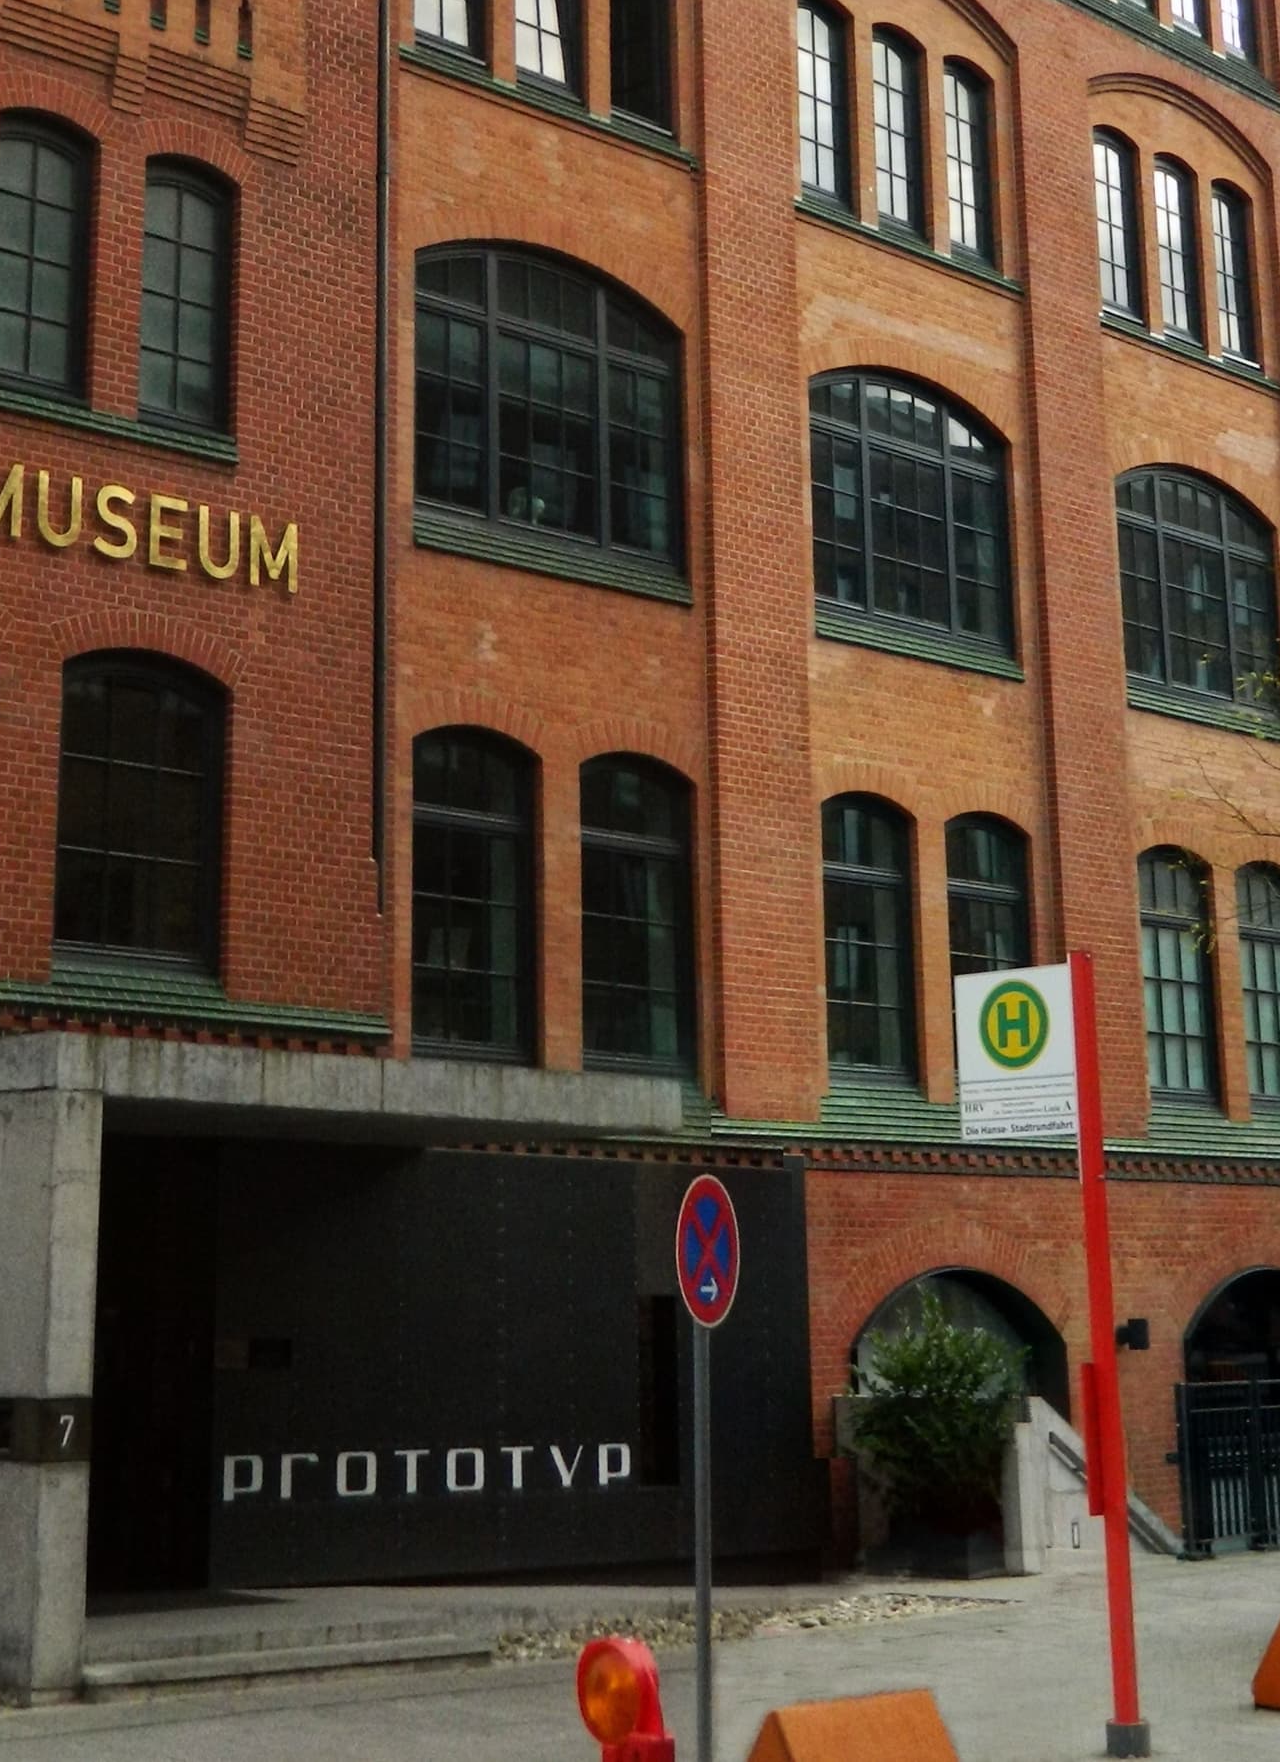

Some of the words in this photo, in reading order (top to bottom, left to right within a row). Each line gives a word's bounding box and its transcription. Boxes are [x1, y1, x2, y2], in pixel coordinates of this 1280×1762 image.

[997, 1000, 1030, 1049] H
[965, 1126, 980, 1136] Die
[1010, 1120, 1074, 1134] Stadtrundfahrt
[59, 1414, 75, 1447] 7
